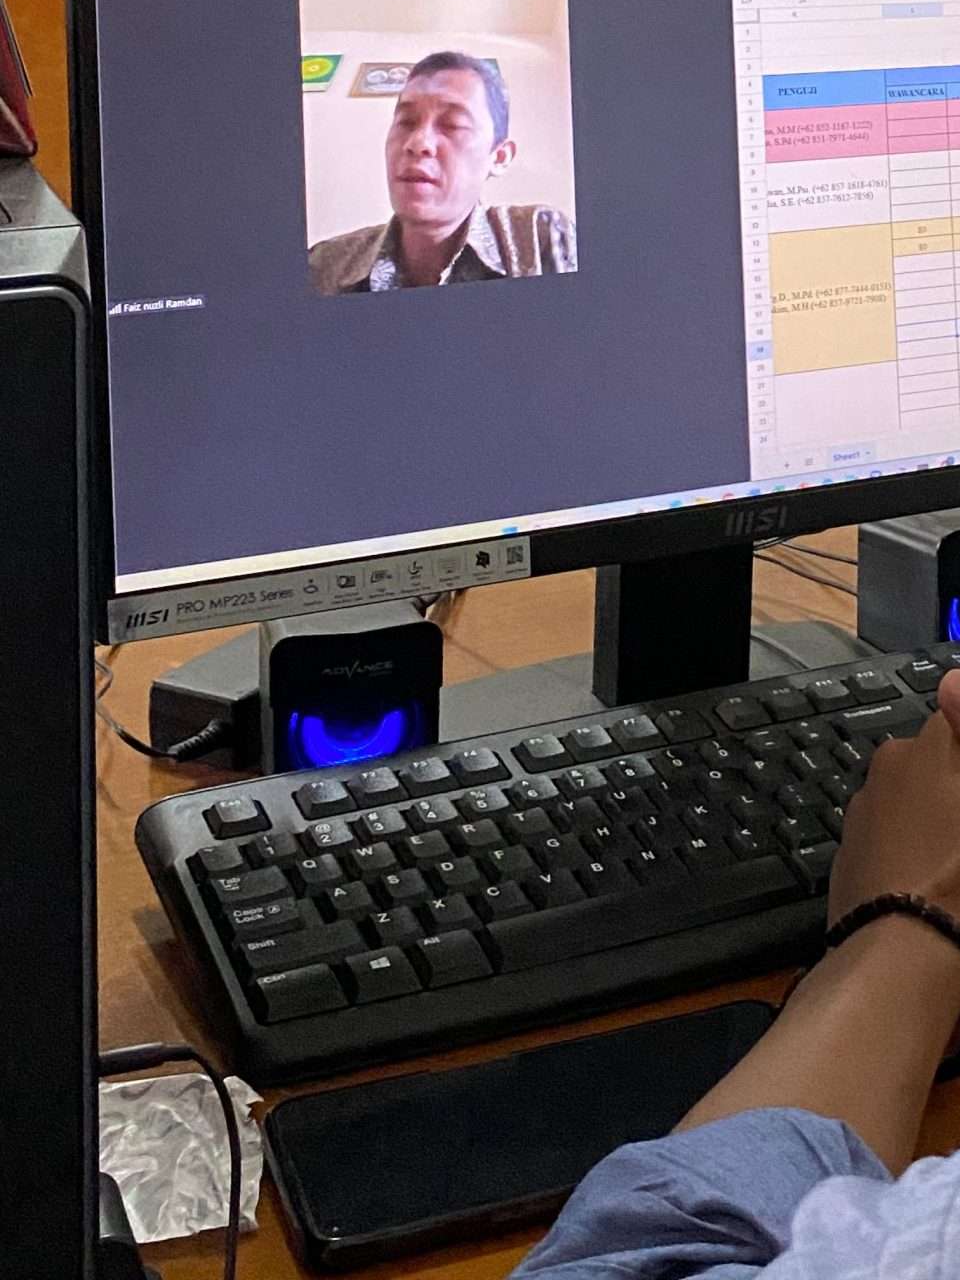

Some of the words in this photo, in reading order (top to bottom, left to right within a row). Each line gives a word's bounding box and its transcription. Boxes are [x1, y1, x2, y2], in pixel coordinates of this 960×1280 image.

[888, 87, 945, 98] WAWANCARA
[123, 302, 142, 313] Faiz
[165, 297, 203, 308] Ramdan
[176, 599, 206, 617] PRO
[260, 588, 296, 603] Series
[708, 770, 723, 780] O
[476, 799, 489, 809] 5
[563, 801, 575, 812] Y
[424, 810, 438, 820] 4
[694, 806, 708, 816] K
[512, 812, 526, 822] T
[372, 821, 384, 832] 3
[462, 823, 477, 834] R
[596, 826, 611, 838] H
[320, 833, 332, 844] 2
[409, 835, 425, 845] E
[546, 837, 561, 849] G
[691, 838, 707, 849] M
[356, 847, 375, 858] W
[493, 850, 505, 861] F
[641, 850, 656, 862] N
[302, 859, 318, 870] Q
[440, 861, 454, 872] D
[590, 862, 604, 873] B
[386, 874, 400, 886] S
[539, 873, 553, 884] V
[333, 887, 347, 898] A
[486, 886, 501, 897] C
[432, 899, 446, 910] X
[232, 907, 264, 919] Caps
[235, 912, 266, 924] Lock
[376, 912, 391, 923] Z
[246, 938, 277, 951] Shift
[422, 936, 442, 946] Alt
[263, 973, 287, 985] Ctrl
